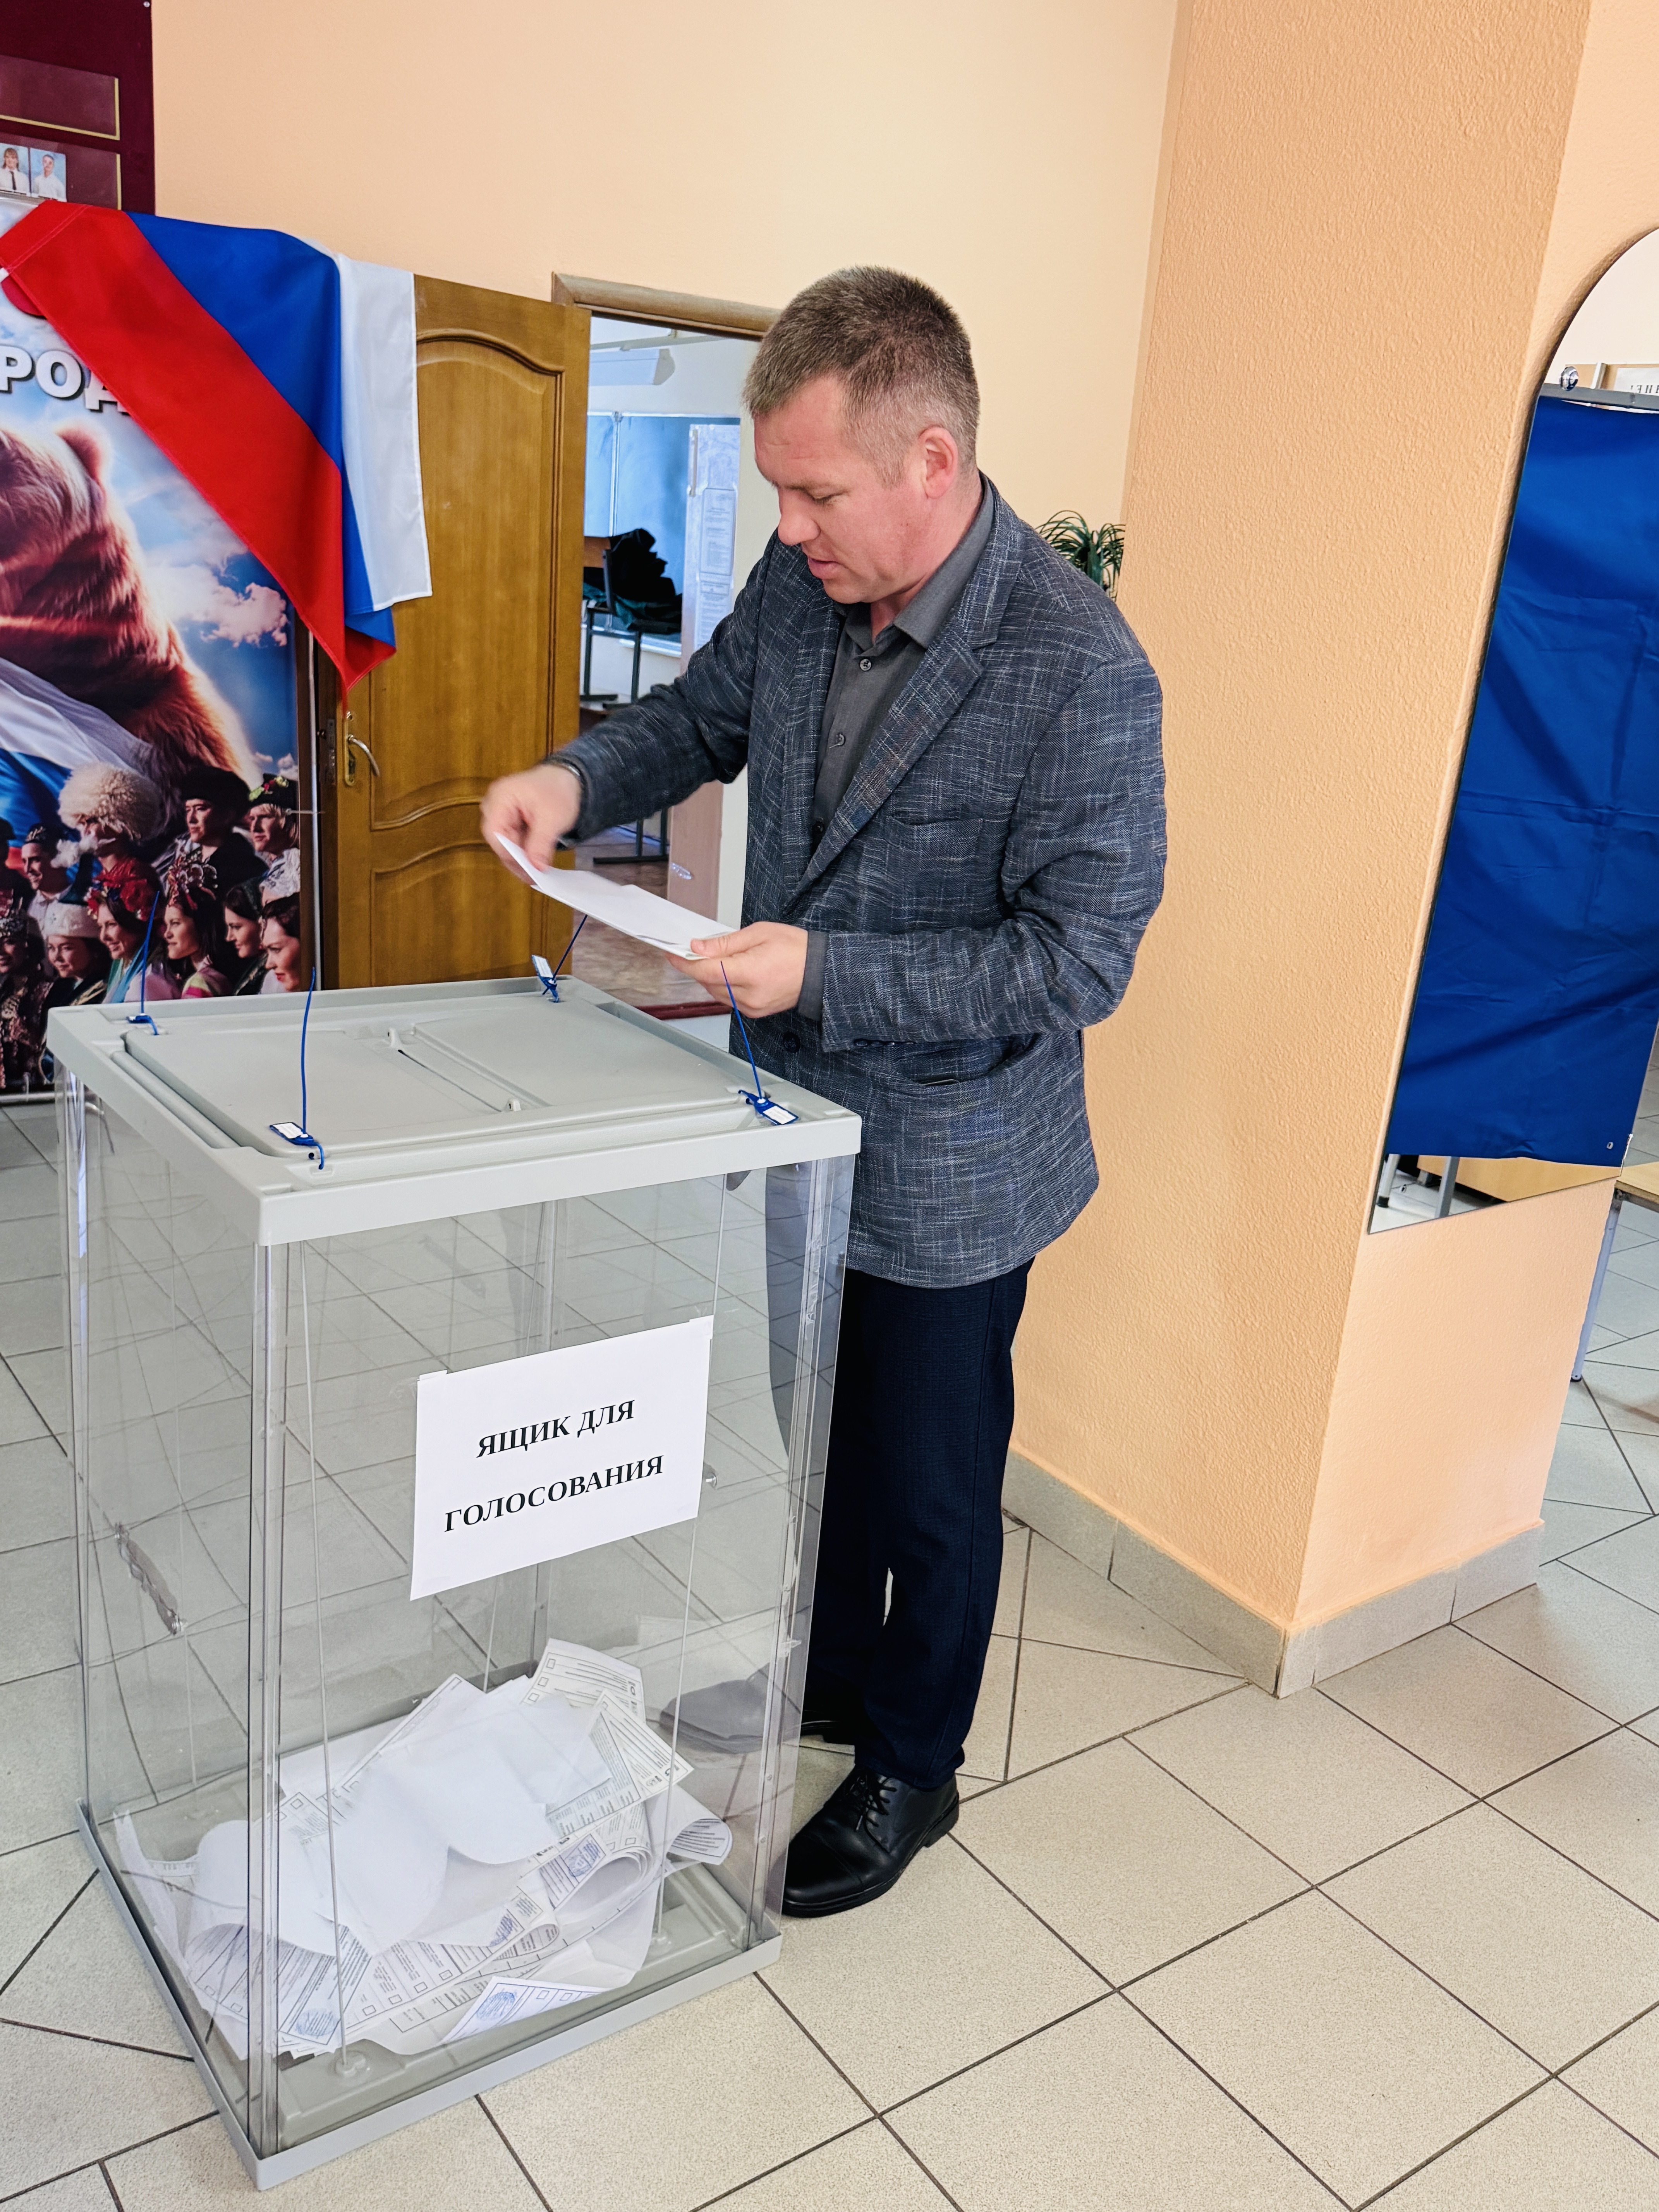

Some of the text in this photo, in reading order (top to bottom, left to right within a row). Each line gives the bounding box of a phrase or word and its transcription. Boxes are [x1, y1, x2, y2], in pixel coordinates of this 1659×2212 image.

[476, 1400, 635, 1458] ЯЩИК ДЛЯ
[444, 1455, 664, 1532] ГОЛОСОВАНИЯ
